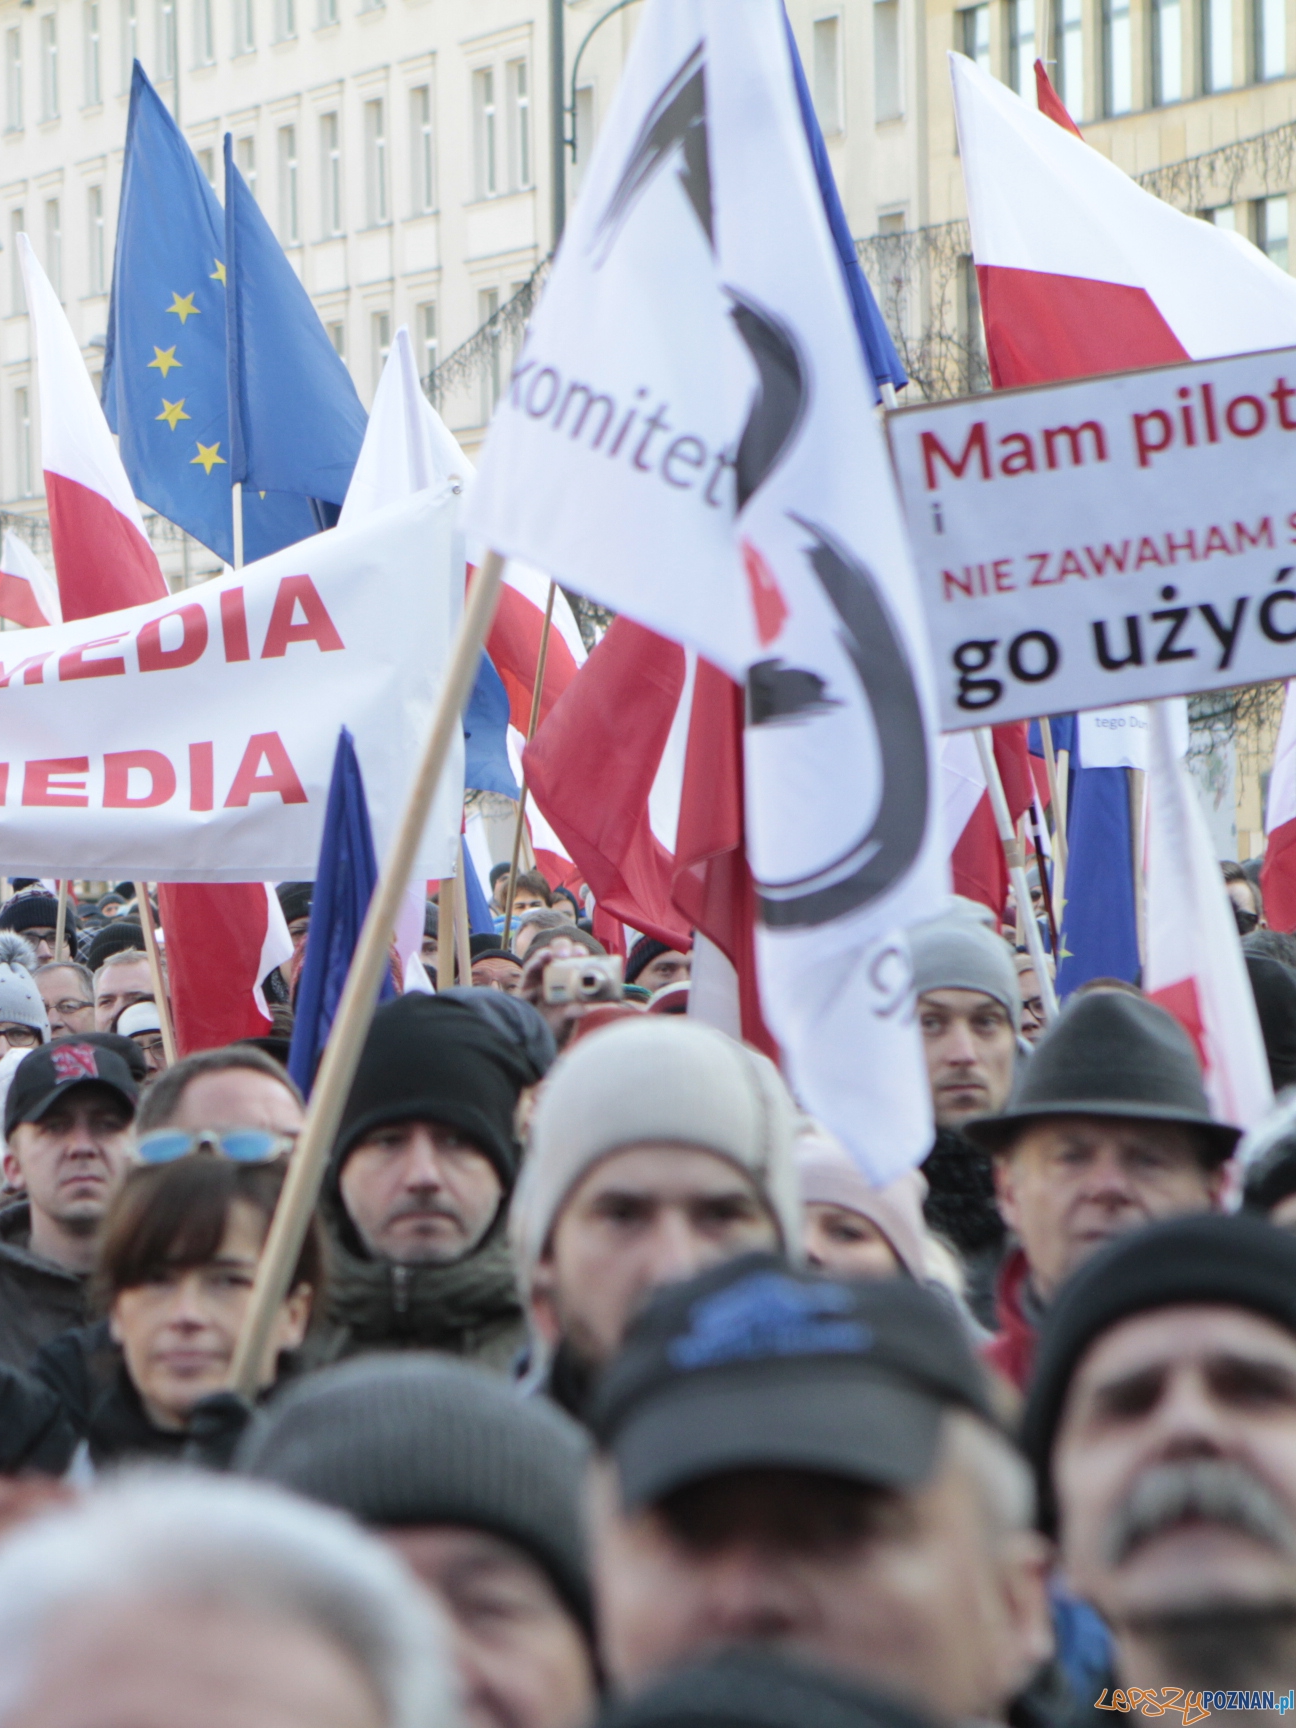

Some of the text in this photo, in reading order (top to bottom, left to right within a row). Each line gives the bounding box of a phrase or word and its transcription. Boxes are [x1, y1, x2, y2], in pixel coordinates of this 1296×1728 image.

[918, 421, 1109, 491] Mam
[932, 502, 945, 535] i
[940, 557, 1018, 602] NIE
[1025, 515, 1276, 588] ZAWAHAM
[952, 566, 1296, 711] go użyć
